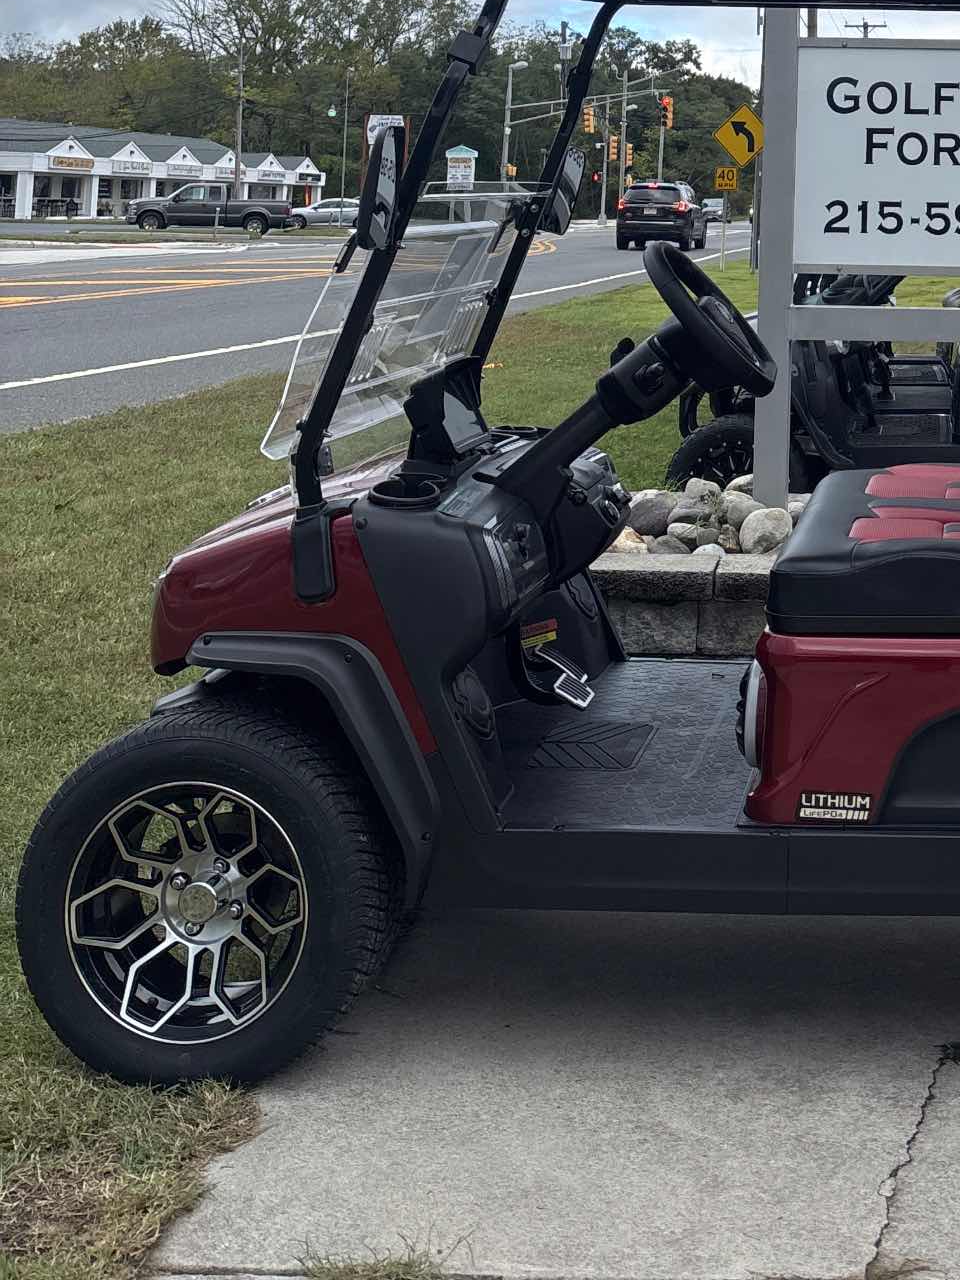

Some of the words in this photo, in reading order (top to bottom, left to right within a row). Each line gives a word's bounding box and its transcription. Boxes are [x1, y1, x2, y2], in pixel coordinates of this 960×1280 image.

[827, 77, 960, 116] GOLF
[718, 169, 735, 181] 40
[801, 793, 870, 809] LITHIUM
